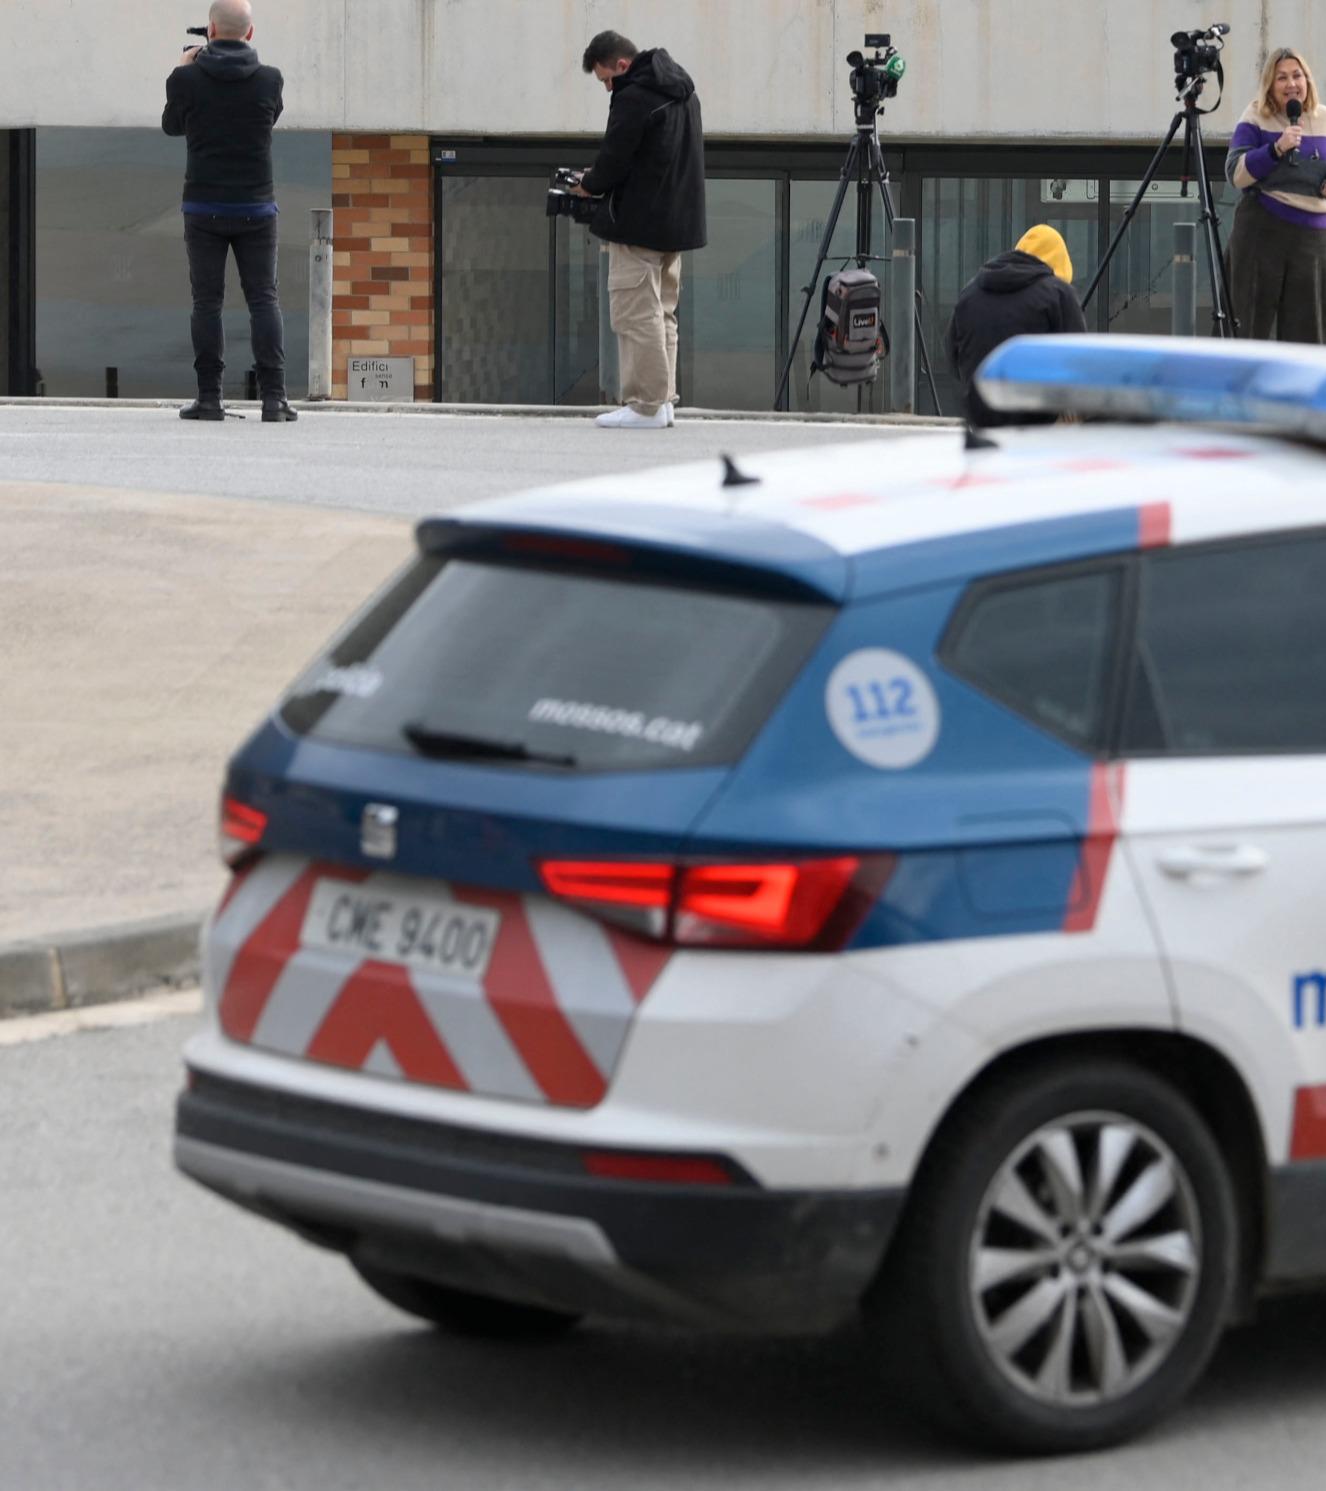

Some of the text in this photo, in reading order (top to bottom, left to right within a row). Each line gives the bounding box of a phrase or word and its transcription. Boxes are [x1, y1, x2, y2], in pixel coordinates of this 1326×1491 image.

[352, 361, 389, 371] Edifici
[528, 697, 702, 751] mossos.cat
[844, 676, 919, 723] 112
[397, 906, 489, 970] 9400
